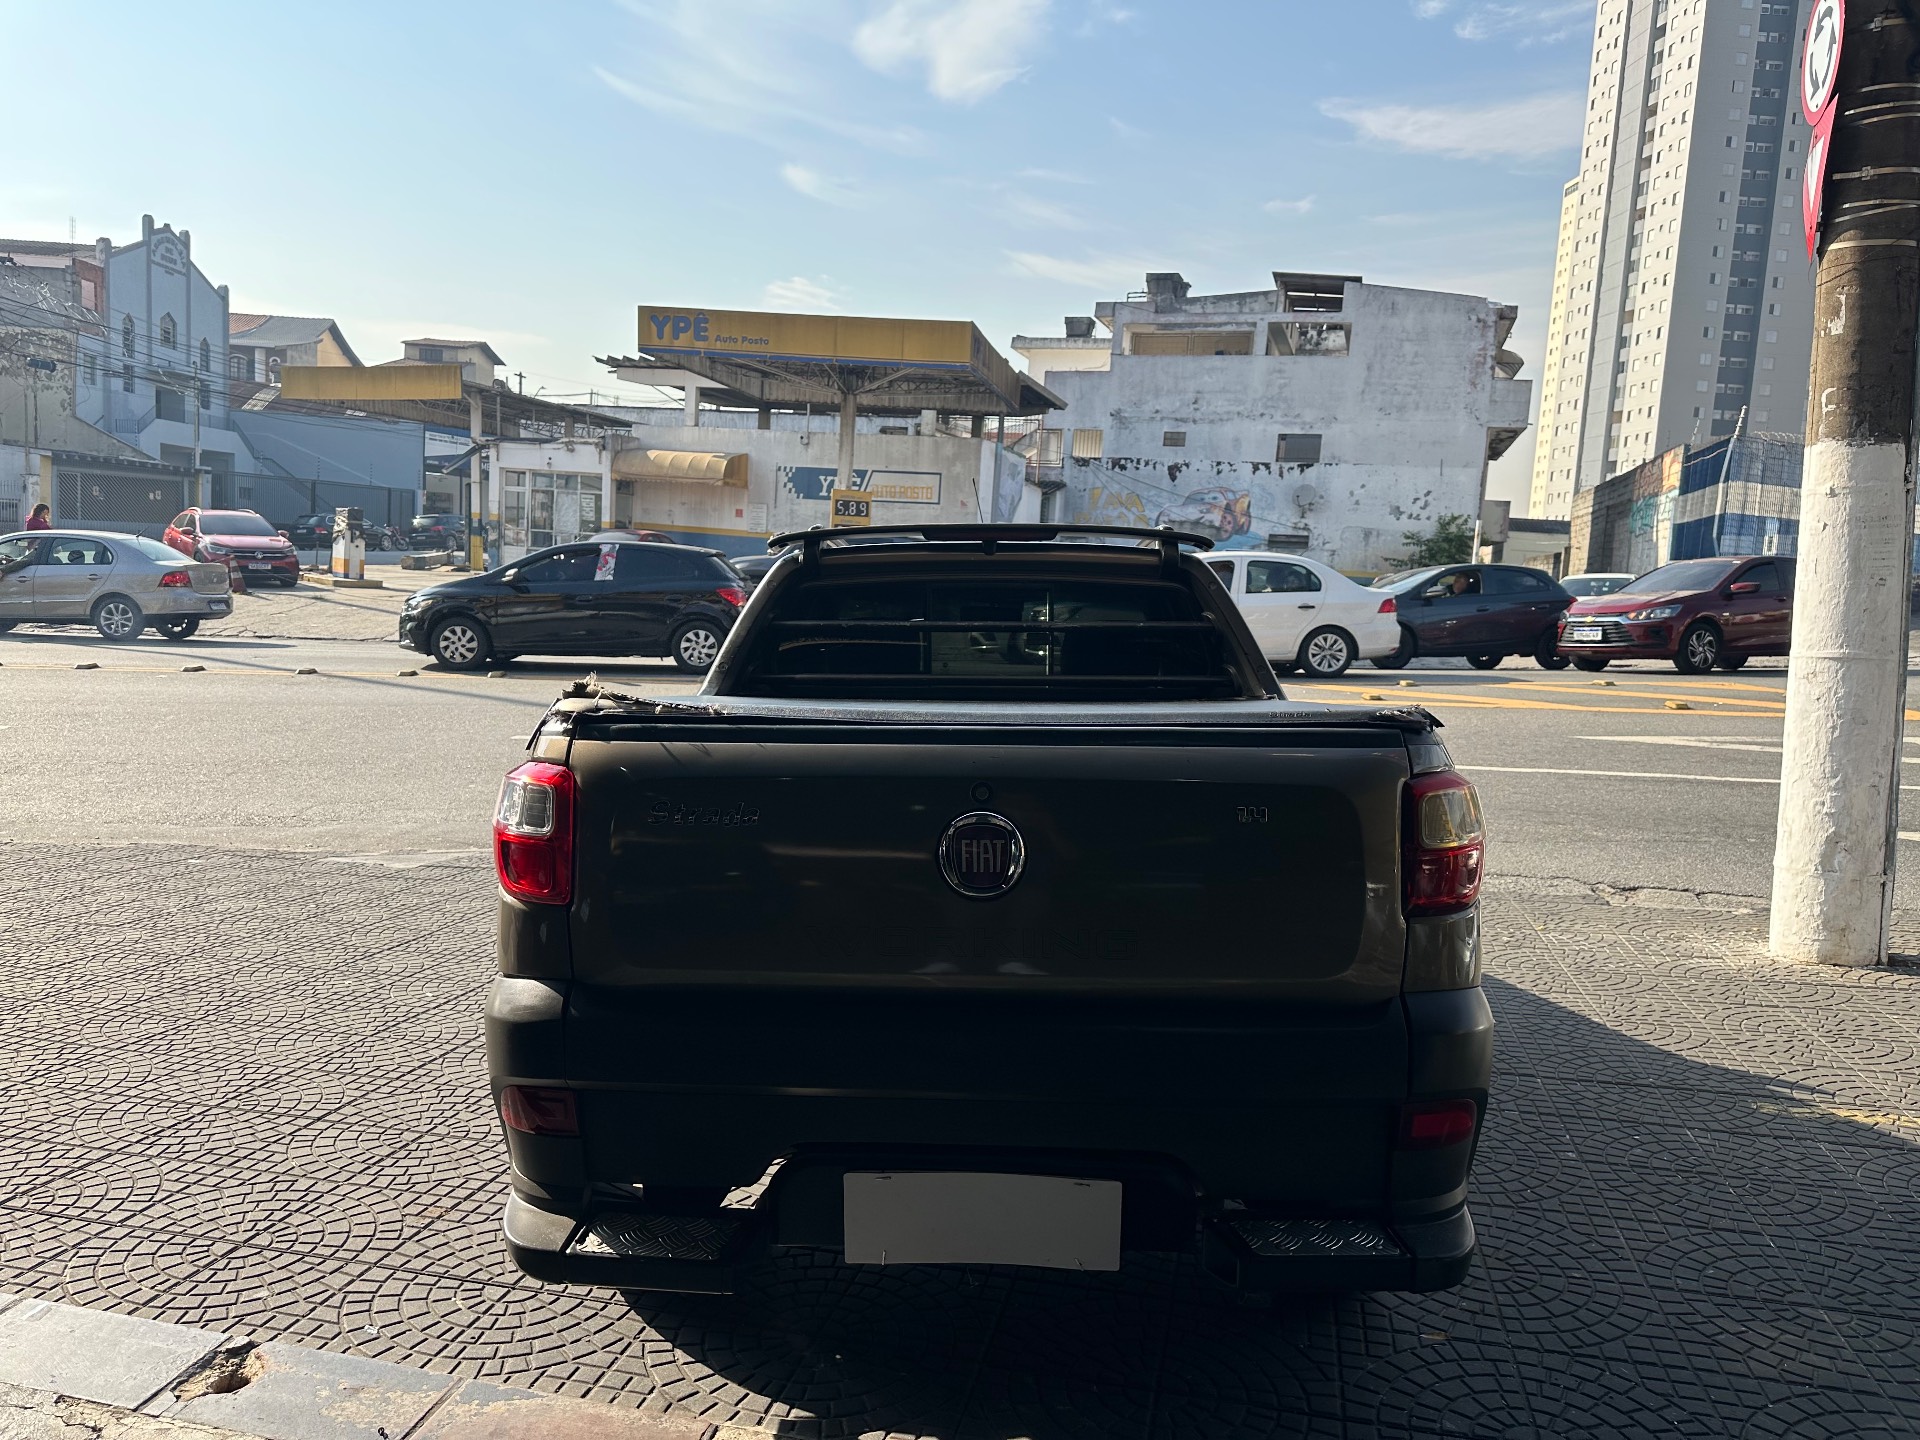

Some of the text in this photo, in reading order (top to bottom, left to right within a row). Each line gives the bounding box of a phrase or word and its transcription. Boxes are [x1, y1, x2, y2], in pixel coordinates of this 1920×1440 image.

[650, 311, 709, 342] YPÊ
[714, 335, 770, 346] Auto Posto
[898, 485, 934, 500] POSTO
[836, 500, 867, 516] 5,89
[647, 799, 760, 828] Strada
[1236, 806, 1269, 823] 1.4
[961, 839, 1005, 873] FIAT
[804, 926, 1142, 960] WORKING
